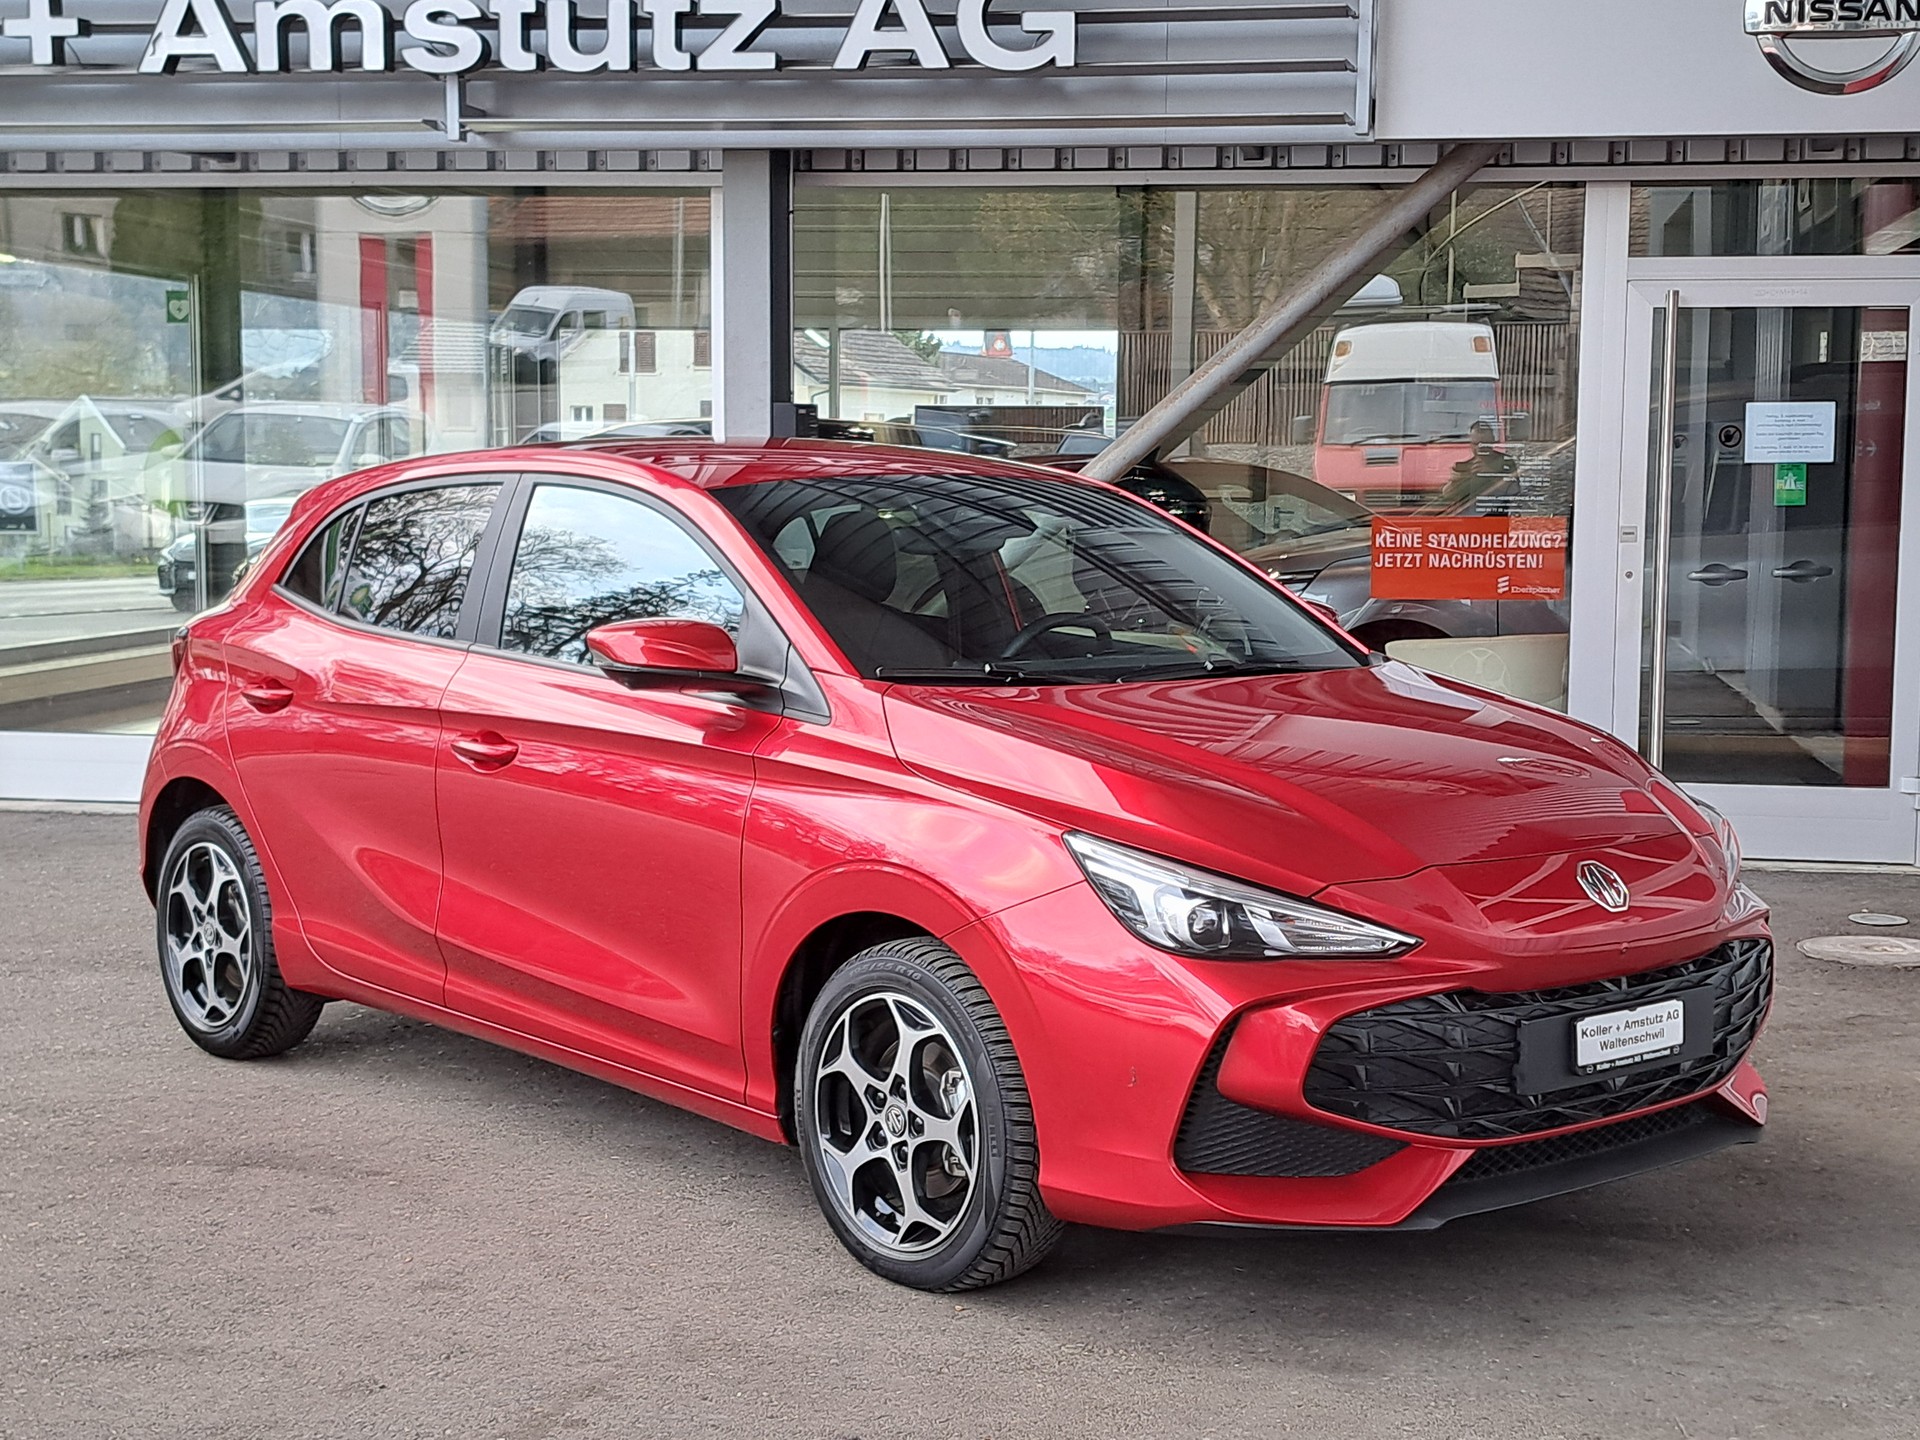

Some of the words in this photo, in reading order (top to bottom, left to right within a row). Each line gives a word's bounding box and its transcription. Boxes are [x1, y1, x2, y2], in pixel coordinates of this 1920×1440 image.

[1764, 0, 1920, 25] NISSAN
[138, 0, 780, 75] Amstutz
[832, 0, 1076, 72] AG
[1375, 532, 1423, 549] KEINE
[1428, 533, 1562, 549] STANDHEIZUNG?
[1374, 553, 1423, 569] JETZT
[1428, 551, 1543, 569] NACHRÜSTEN!
[1580, 1025, 1613, 1040] Koller
[1623, 1013, 1664, 1032] Amstutz
[1665, 1008, 1680, 1022] AG
[1599, 1027, 1665, 1052] Waltenschwil
